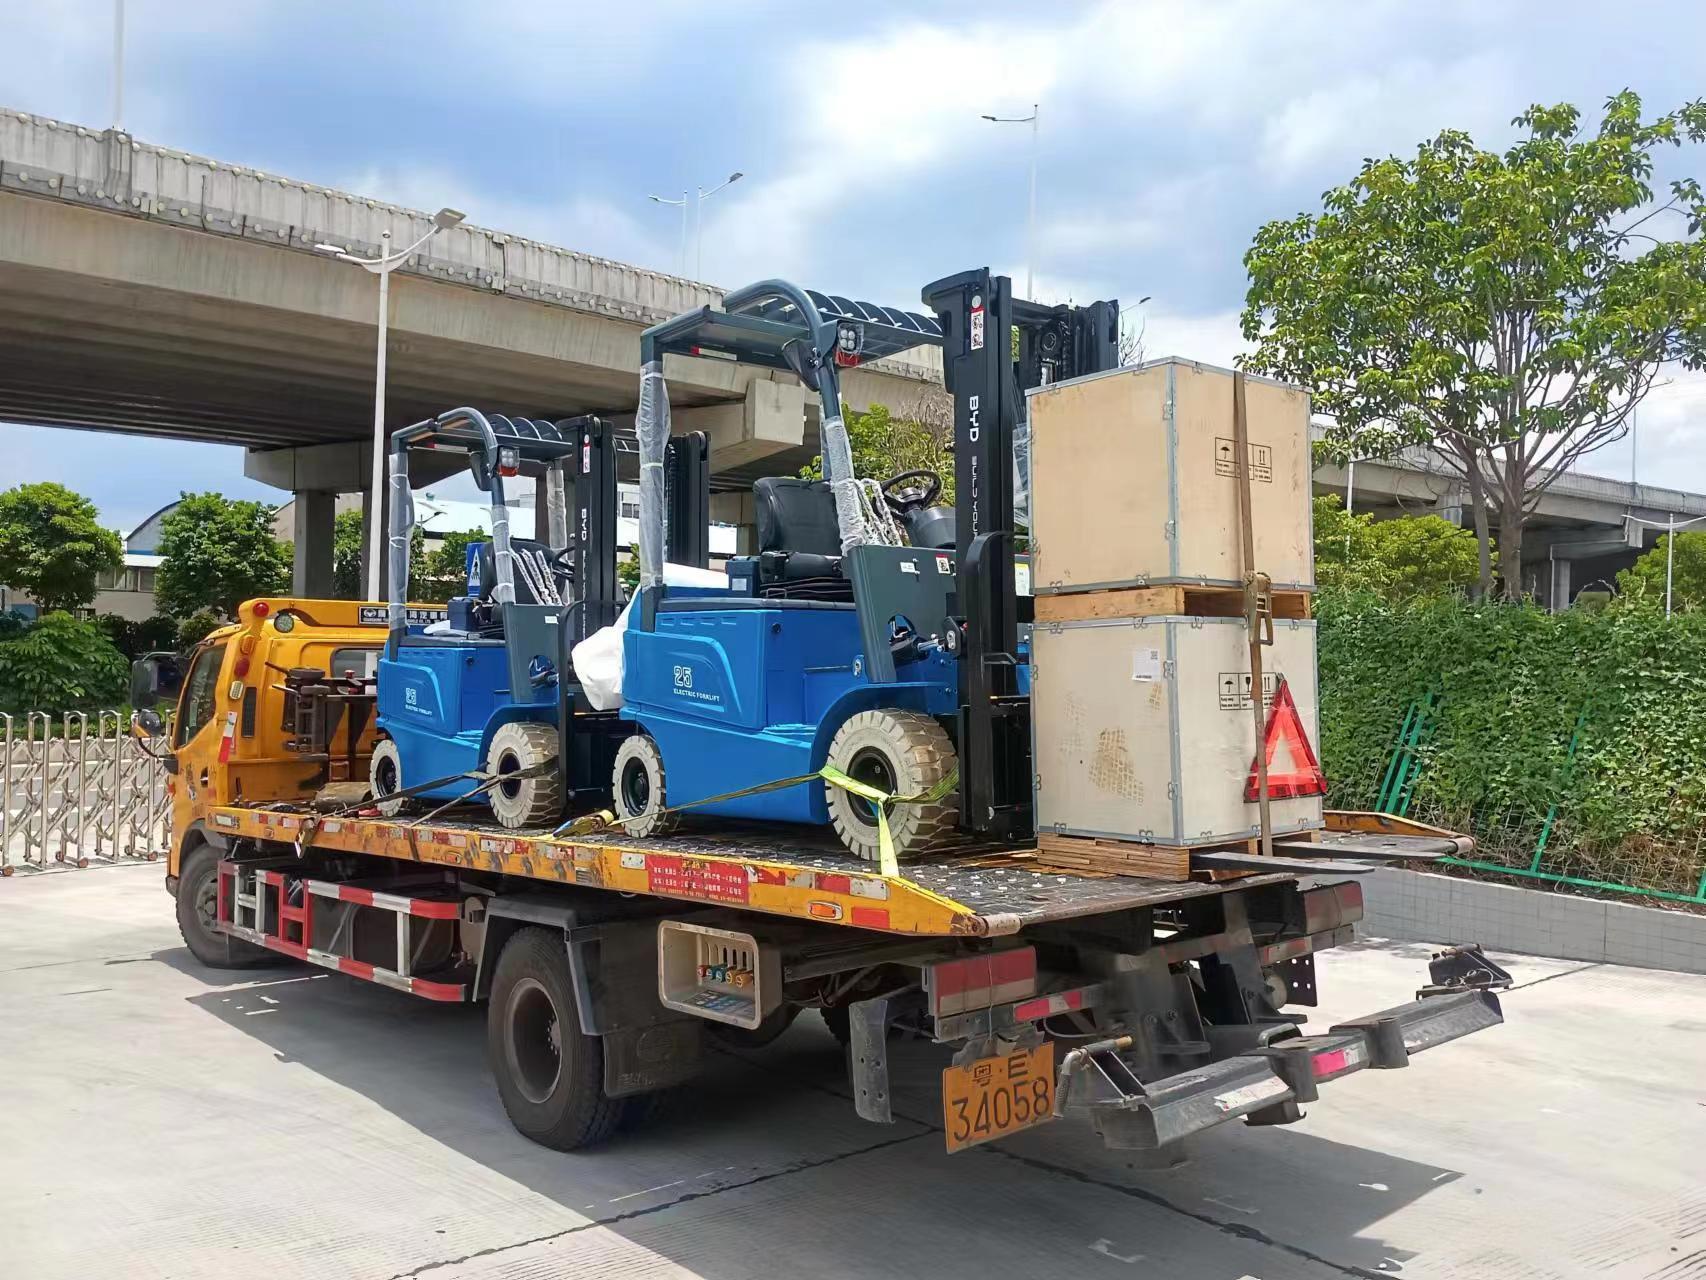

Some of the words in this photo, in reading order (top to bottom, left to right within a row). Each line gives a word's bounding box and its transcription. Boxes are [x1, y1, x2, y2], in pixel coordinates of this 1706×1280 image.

[969, 395, 979, 442] BYD
[971, 455, 979, 498] BUILD
[673, 665, 693, 688] 25
[673, 688, 697, 698] ELECTRIC
[696, 691, 720, 702] FORKLIFT
[952, 1076, 1050, 1142] 34058
